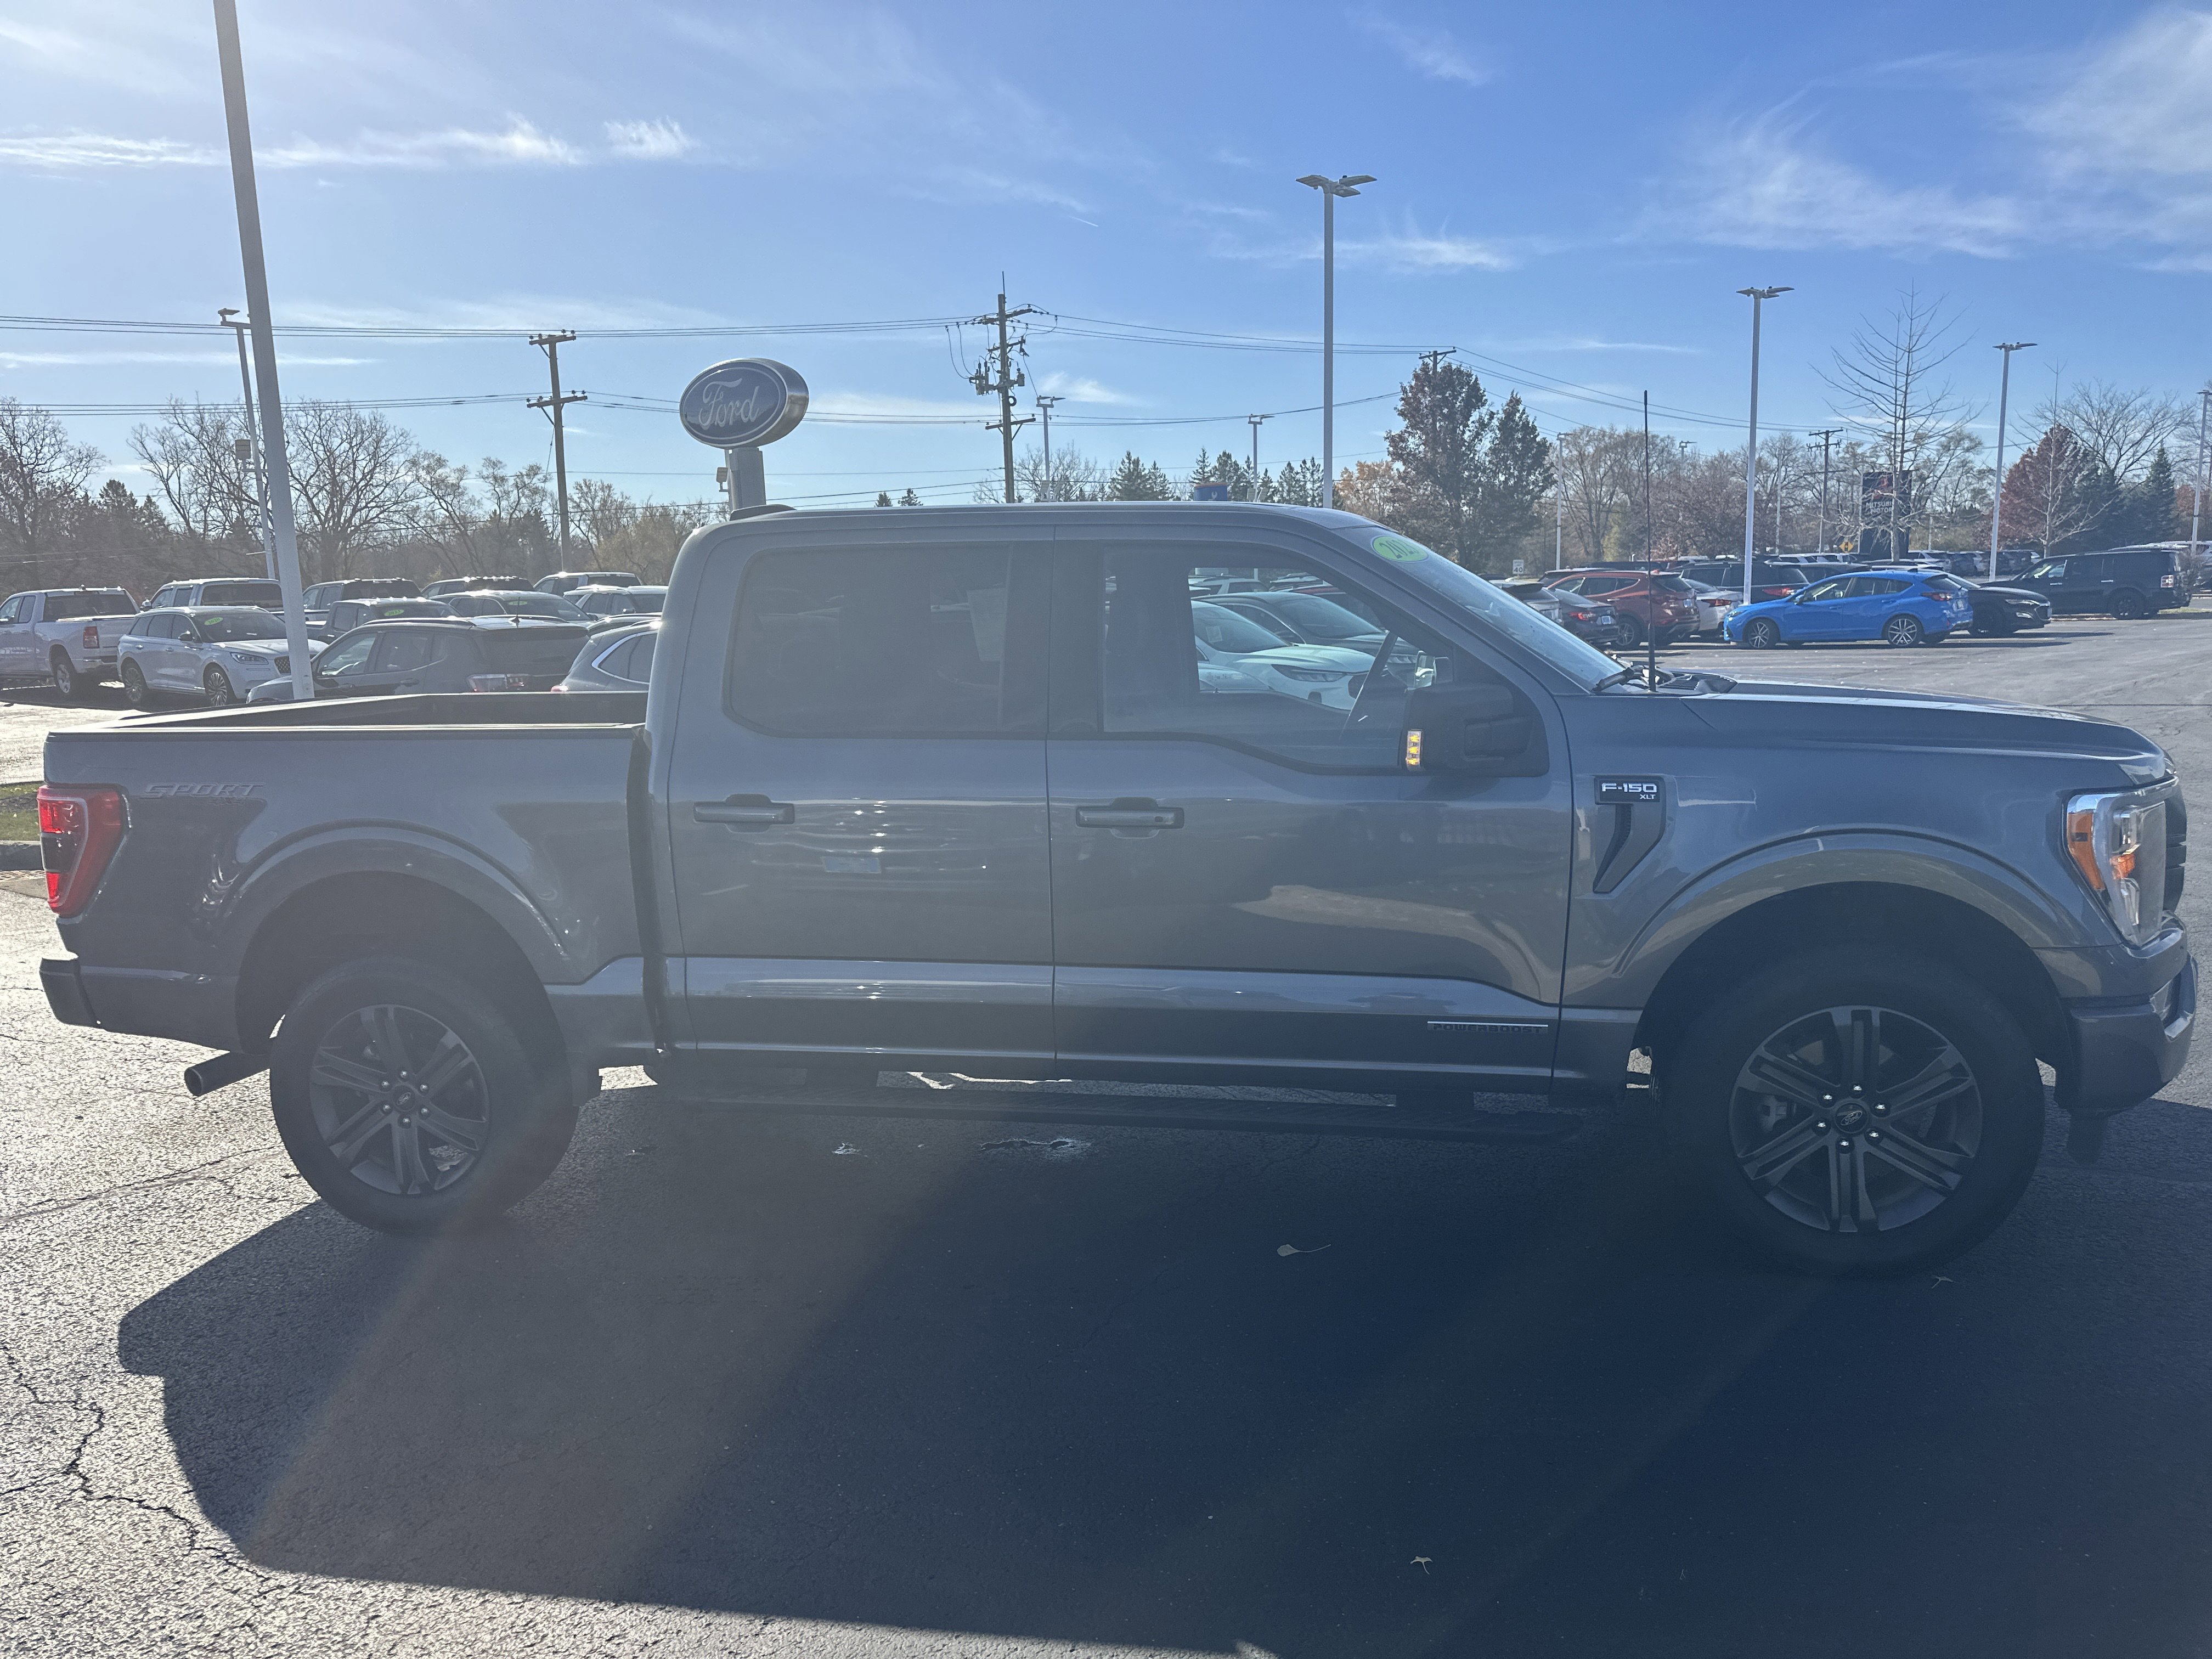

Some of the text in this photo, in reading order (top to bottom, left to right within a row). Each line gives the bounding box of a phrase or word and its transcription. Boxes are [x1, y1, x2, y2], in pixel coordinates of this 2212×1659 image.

[699, 377, 759, 430] Ford
[138, 782, 266, 800] SPORT
[1601, 782, 1657, 793] F-150
[1433, 1023, 1542, 1034] POWERBOOST
